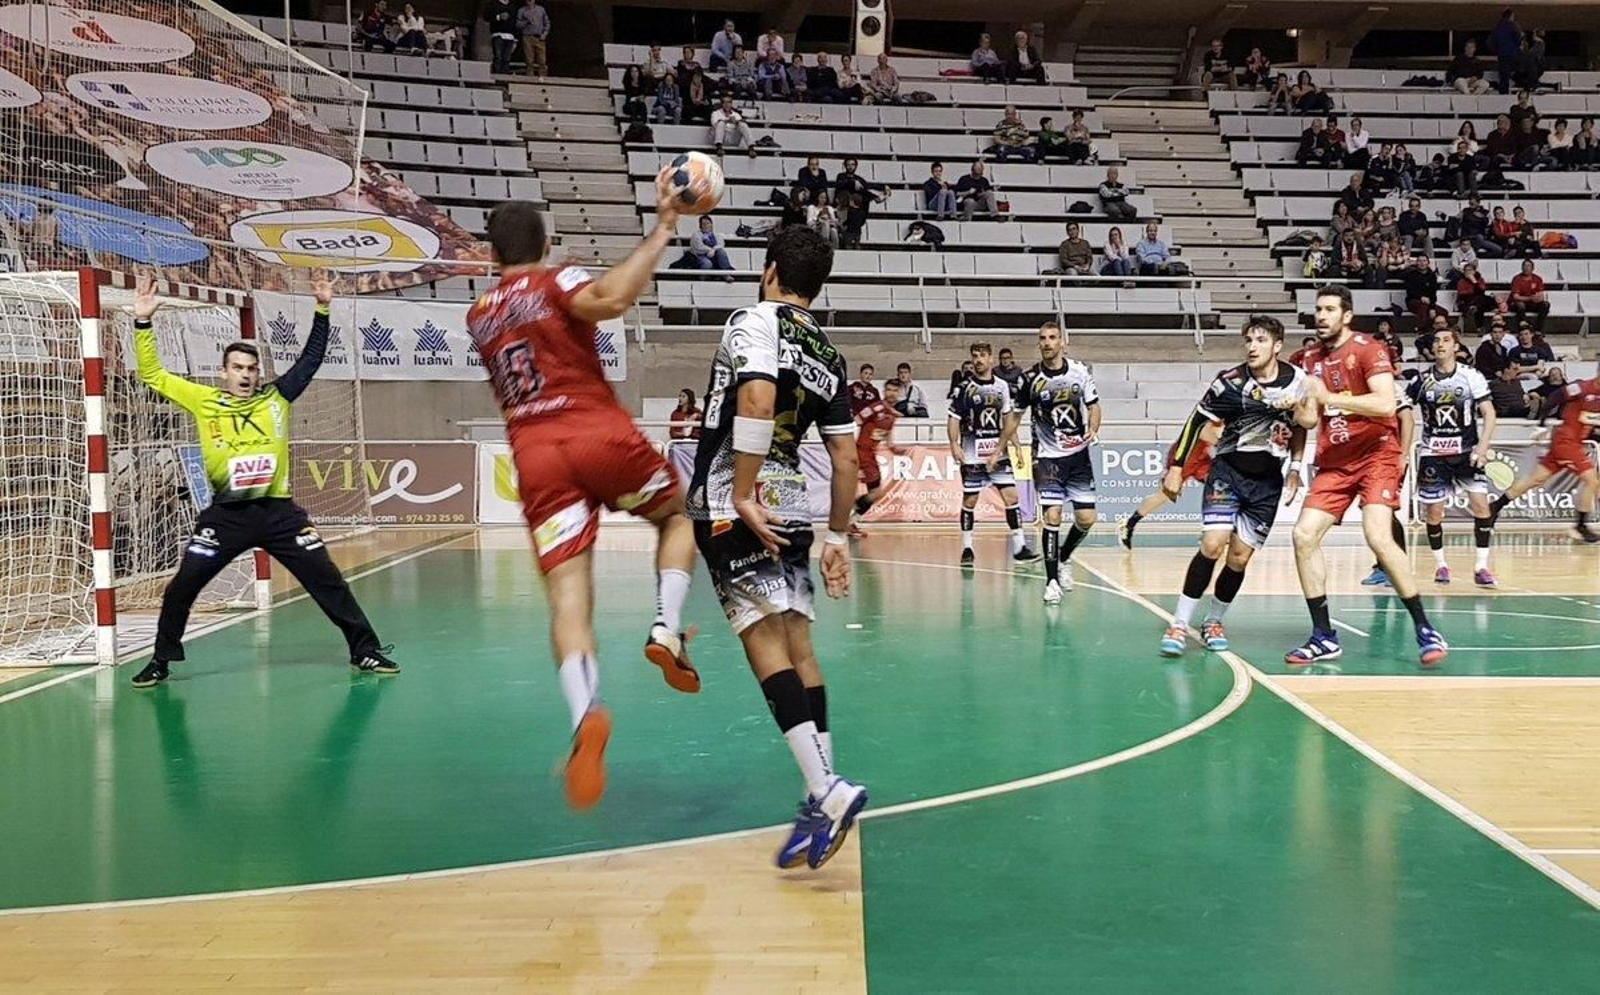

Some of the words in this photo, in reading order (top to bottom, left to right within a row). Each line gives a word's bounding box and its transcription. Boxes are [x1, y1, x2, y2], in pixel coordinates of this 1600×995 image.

[296, 234, 380, 250] Bada
[363, 354, 400, 366] luanvi
[414, 354, 453, 366] luanvi
[1101, 450, 1164, 476] PCB
[729, 549, 771, 572] Fundac
